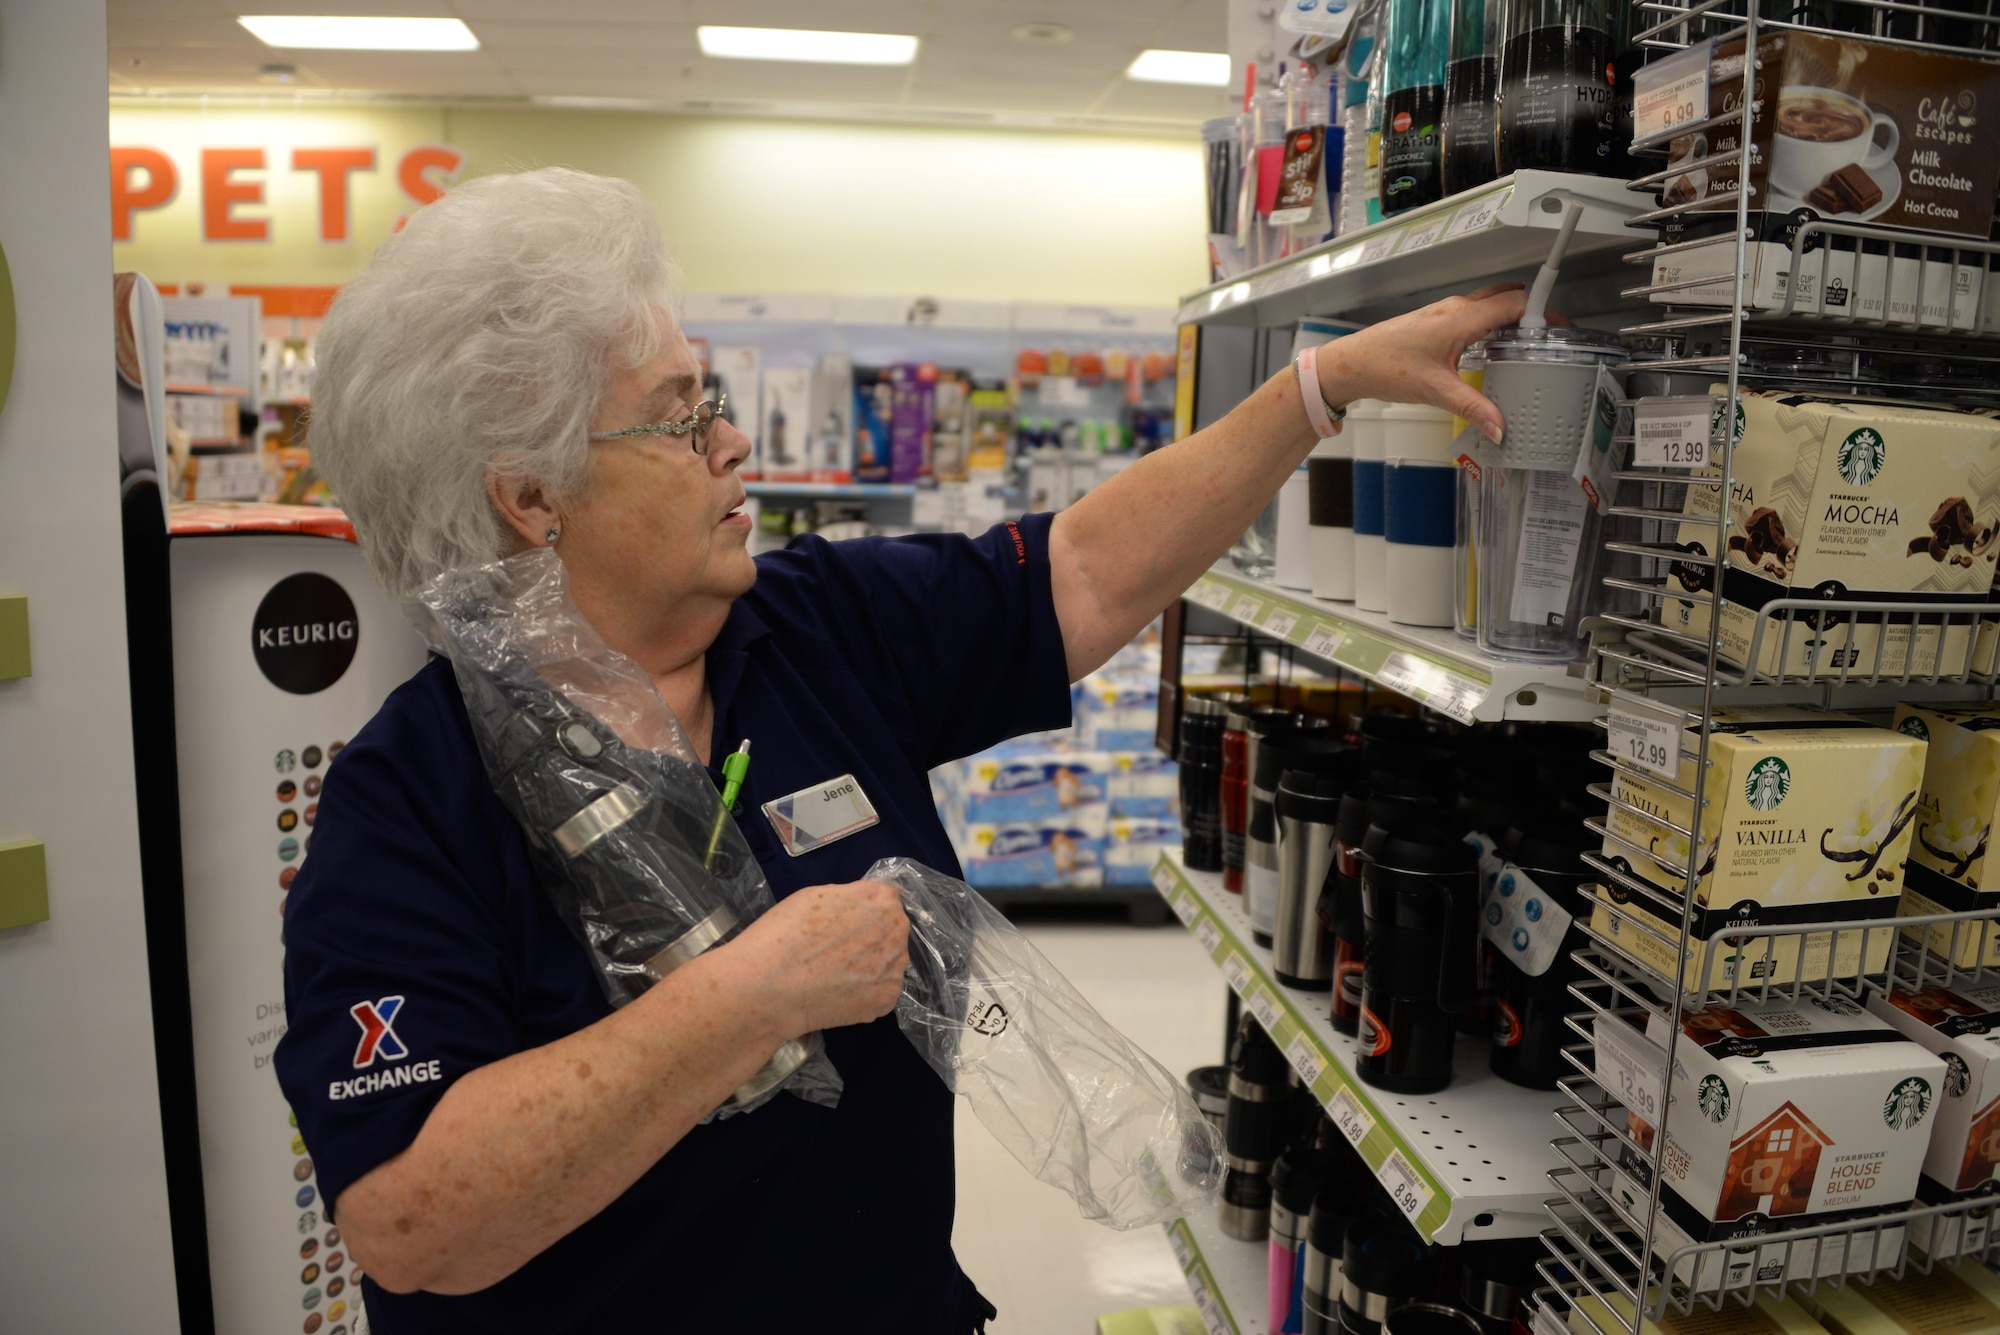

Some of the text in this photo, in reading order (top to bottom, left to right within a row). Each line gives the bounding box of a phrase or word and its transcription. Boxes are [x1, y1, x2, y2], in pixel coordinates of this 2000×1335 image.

[1675, 82, 1686, 93] MILK
[1663, 101, 1694, 128] 9.99
[1918, 96, 1957, 130] Café
[1915, 124, 1973, 145] Escapes
[1716, 137, 1737, 152] Milk
[1911, 148, 1942, 168] Milk
[1711, 180, 1727, 192] Hot
[1909, 168, 1973, 192] Chocolate
[1904, 199, 1960, 219] Hot Cocoa
[1666, 223, 1684, 233] KEURIG
[1777, 278, 1786, 288] 16
[1959, 271, 1969, 283] 70
[1662, 421, 1678, 429] MOCHA
[1529, 450, 1571, 464] COPCO
[1663, 442, 1704, 462] 12.99
[1829, 494, 1869, 502] STARBUCKS
[1824, 504, 1899, 526] MOCHA
[1821, 524, 1887, 537] FLAVORED WITH OTHER
[1818, 534, 1869, 545] NATURAL FLAVOR
[1680, 609, 1689, 621] 16
[259, 620, 353, 649] KEURIG
[1316, 638, 1334, 656] 4.99
[1630, 738, 1667, 768] 12.99
[1620, 776, 1646, 792] STARBUCKS
[823, 784, 854, 802] Jene
[1736, 828, 1807, 846] VANILLA
[1733, 847, 1797, 858] FLAVORED WITH OTHER
[1732, 857, 1781, 866] NATURAL FLAVOR
[1610, 919, 1619, 931] 16
[1724, 918, 1759, 929] KEURIG
[966, 999, 985, 1026] PE-LD
[1759, 1013, 1806, 1023] HOUSE
[1768, 1020, 1812, 1029] BLEND
[1727, 1043, 1758, 1052] KEURIG
[1297, 1054, 1317, 1082] 15.99
[328, 1059, 443, 1101] EXCHANGE
[1619, 1070, 1655, 1114] 12.99
[1340, 1111, 1363, 1142] 14.99
[1834, 1151, 1889, 1163] STARBUCKS
[1625, 1155, 1647, 1182] KEURIG
[1831, 1162, 1882, 1179] HOUSE
[1827, 1177, 1876, 1194] BLEND
[1394, 1183, 1417, 1213] 8.99
[1823, 1195, 1862, 1207] MEDIUM
[1732, 1228, 1767, 1240] KEURIG
[1732, 1271, 1743, 1281] 16
